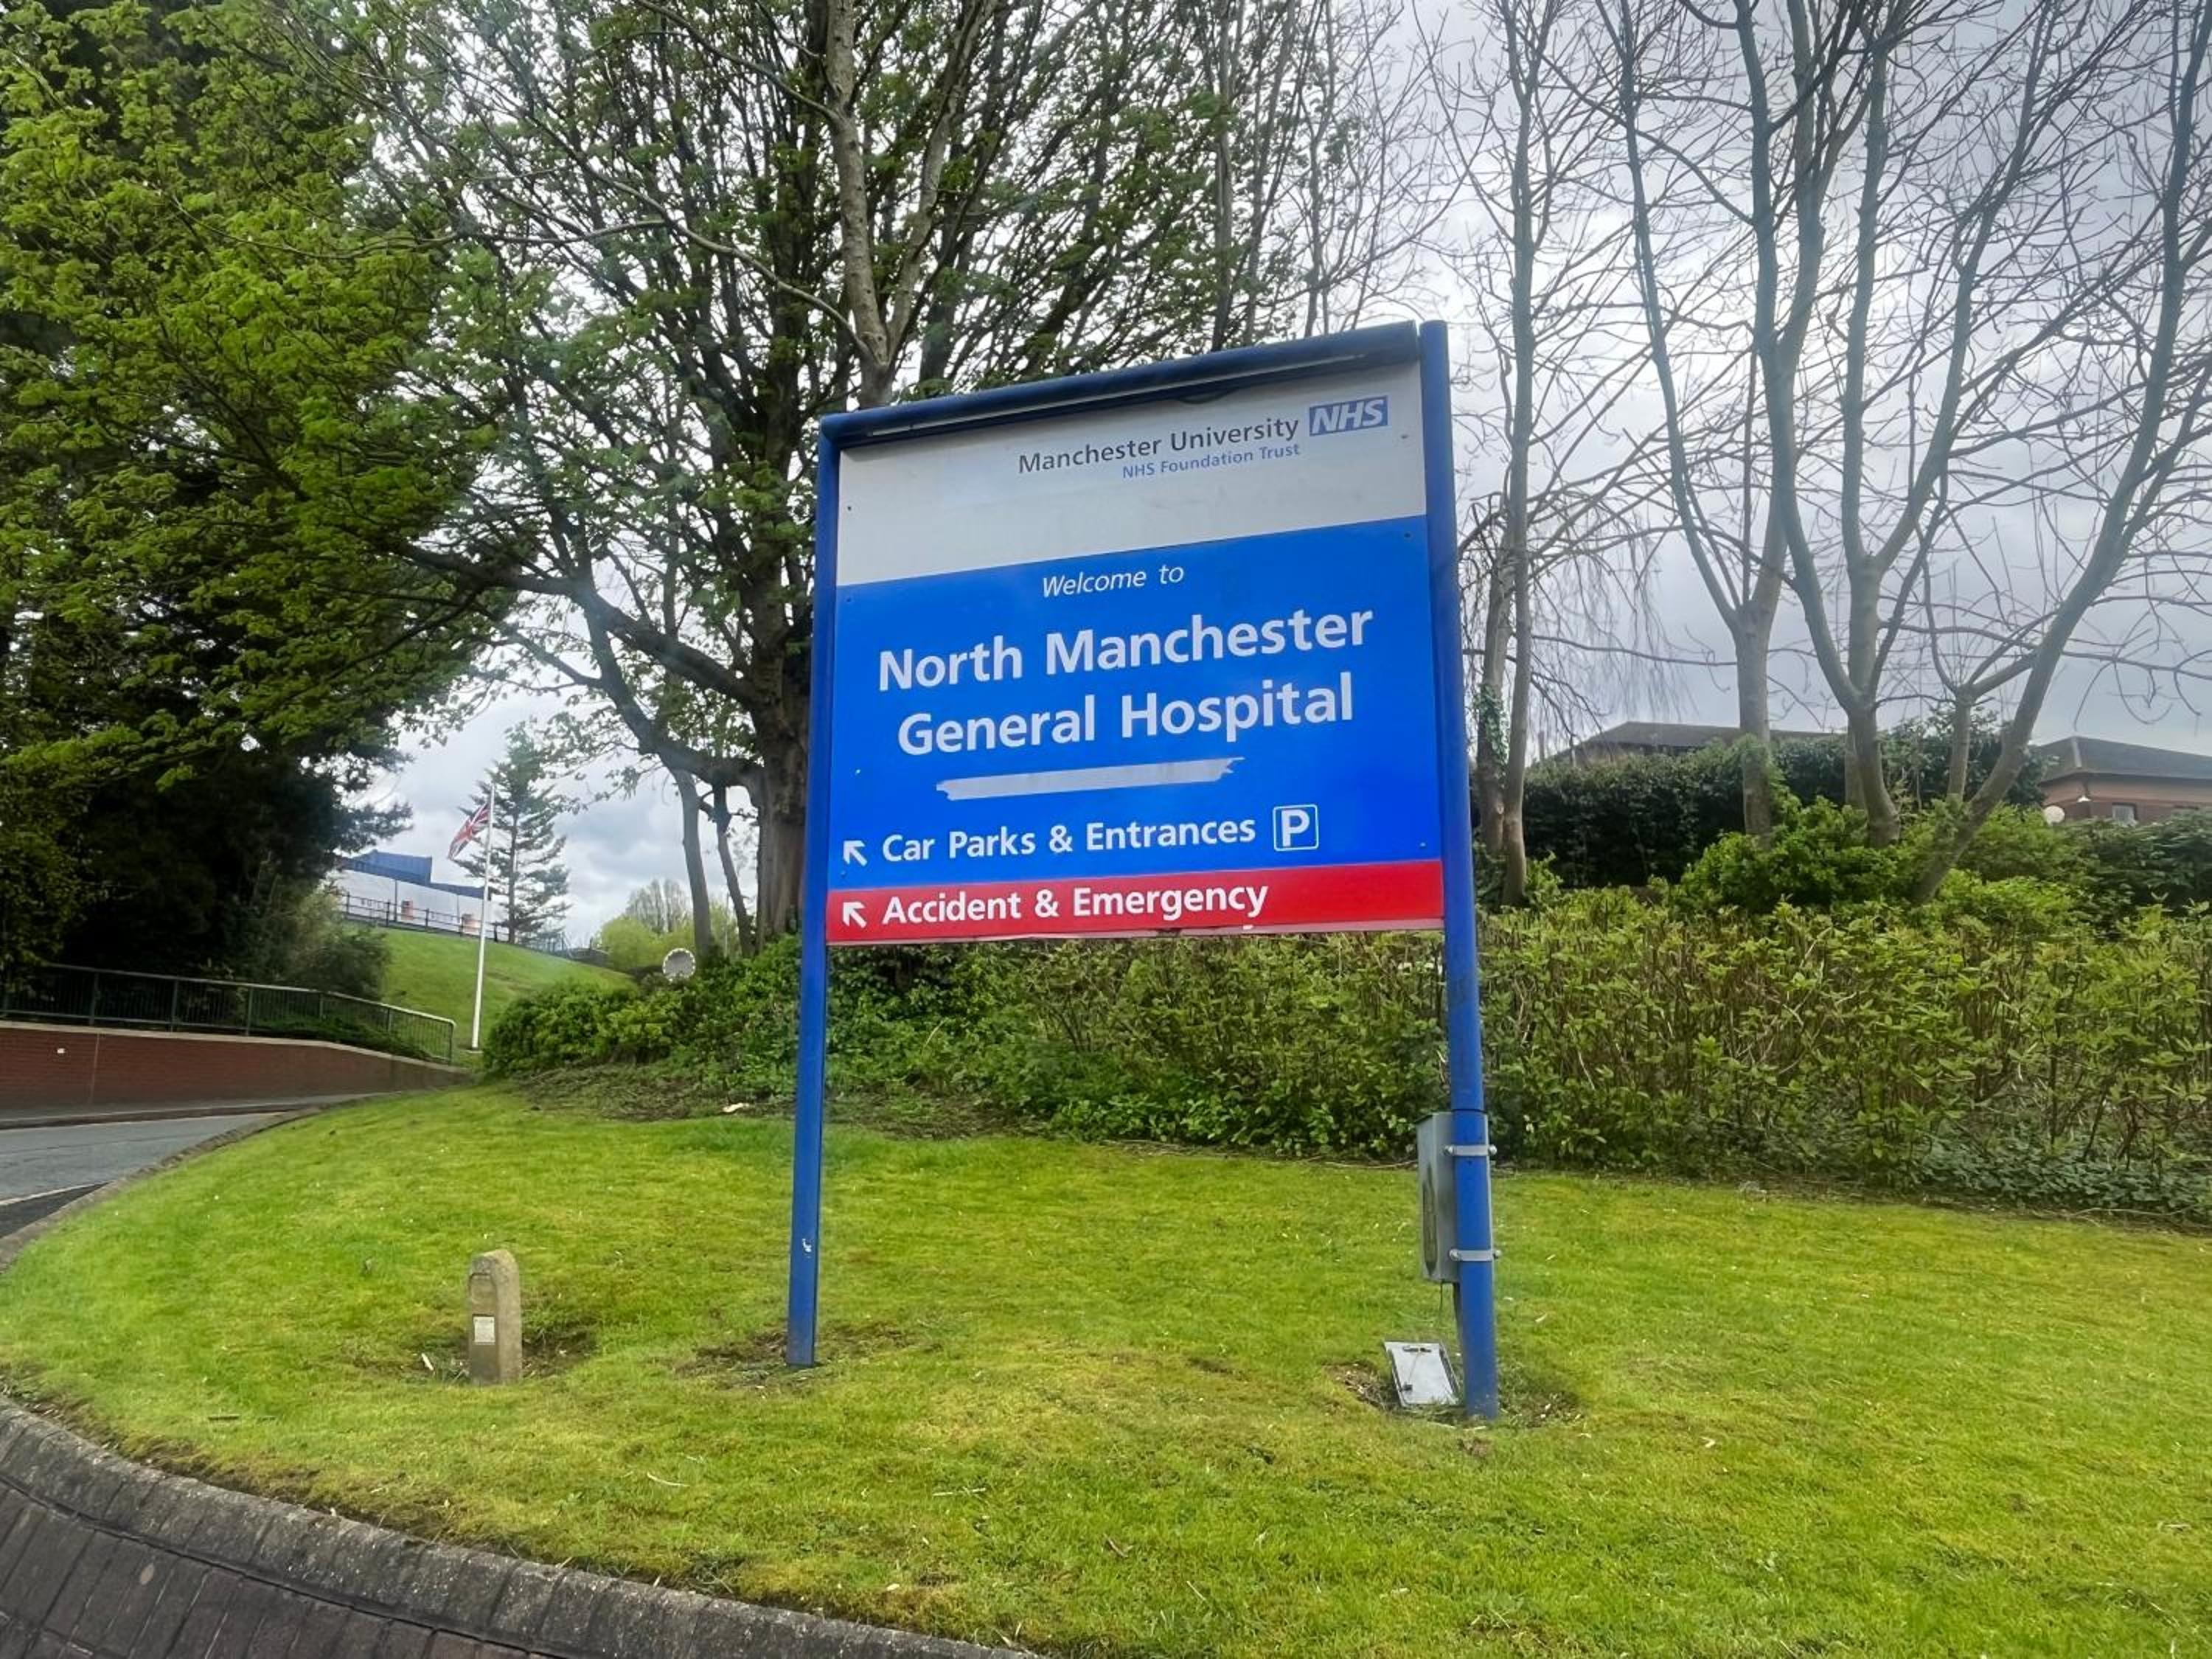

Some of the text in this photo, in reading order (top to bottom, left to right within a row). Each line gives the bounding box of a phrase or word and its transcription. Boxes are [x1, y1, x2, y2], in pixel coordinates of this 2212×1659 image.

[1018, 399, 1384, 474] Manchester University NHS
[1123, 443, 1300, 479] NHS Foundation Trust
[1043, 566, 1184, 597] Welcome to
[880, 610, 1372, 691] North Manchester
[898, 672, 1352, 756] General Hospital
[883, 810, 1310, 862] Car Parks & Entrances P
[882, 886, 1269, 925] Accident & Emergency
